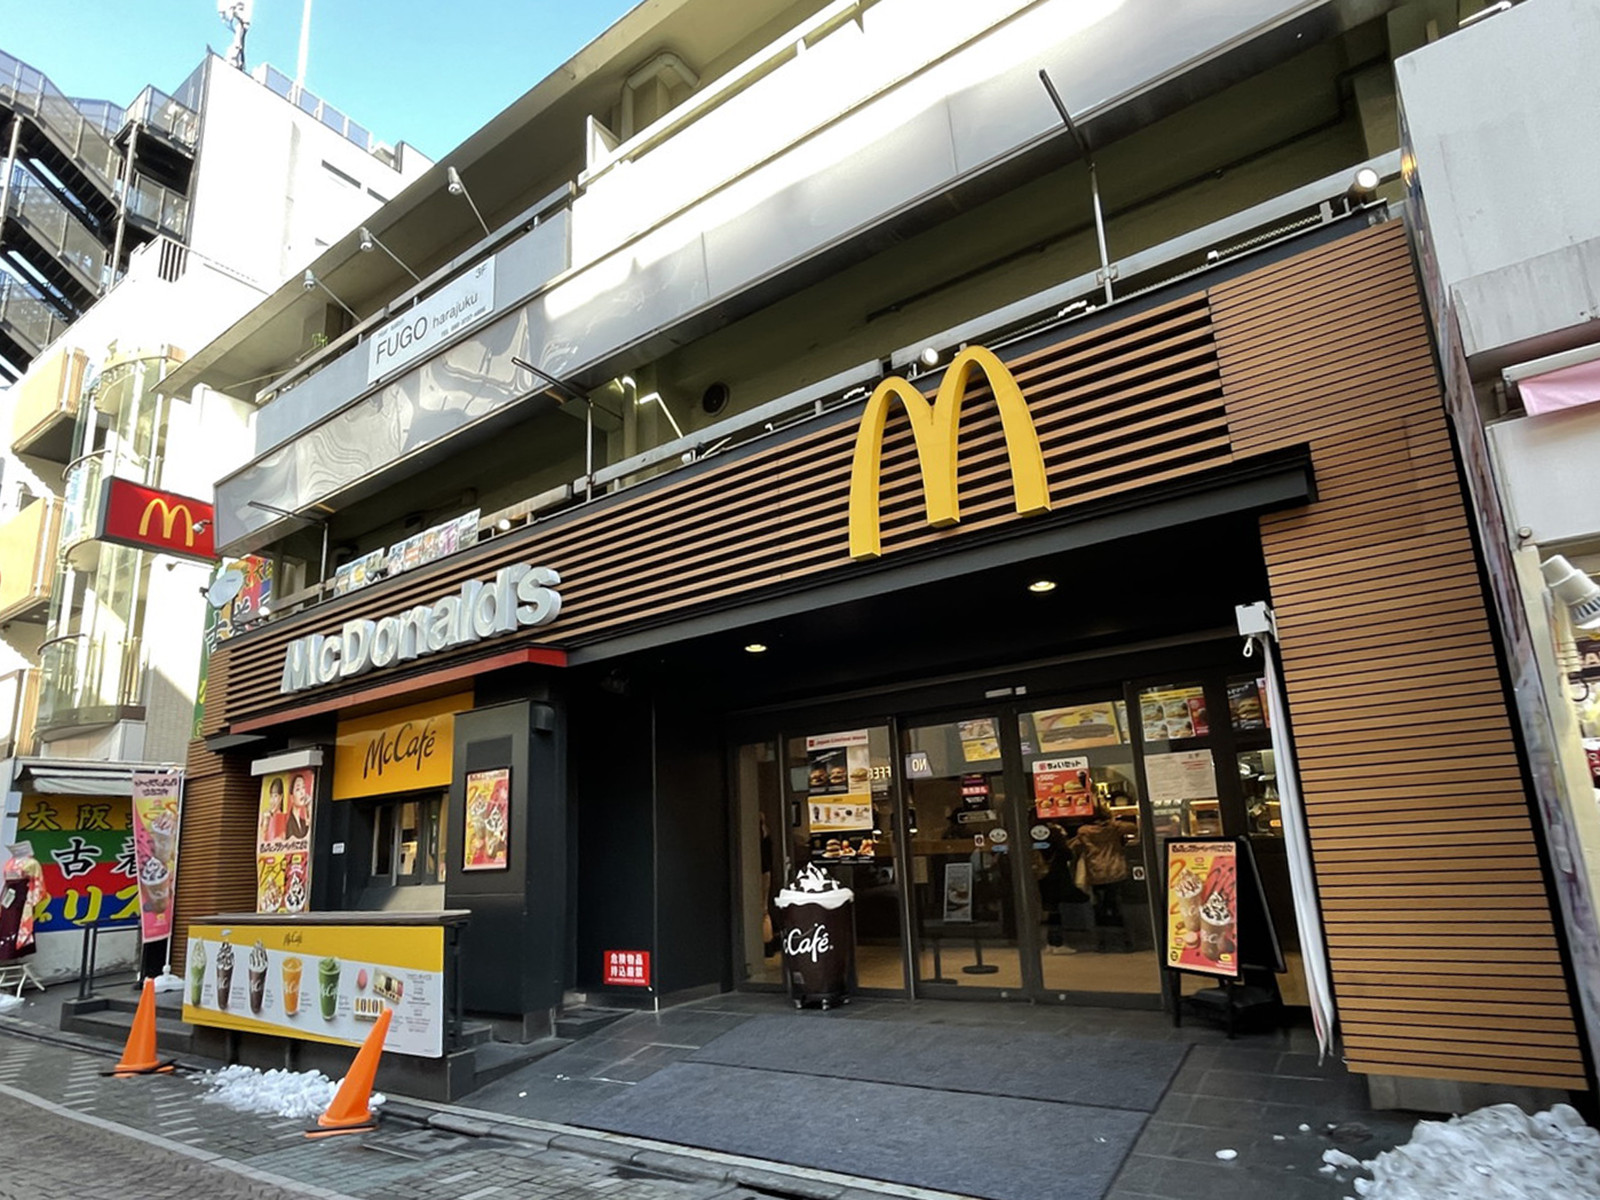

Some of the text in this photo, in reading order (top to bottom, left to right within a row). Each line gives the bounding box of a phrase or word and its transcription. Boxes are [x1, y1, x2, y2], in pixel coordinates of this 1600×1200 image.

[475, 263, 487, 279] 3F
[376, 316, 428, 365] FUGO
[432, 293, 478, 329] harajuku
[280, 562, 562, 694] McDonald's
[363, 718, 437, 780] McCafé
